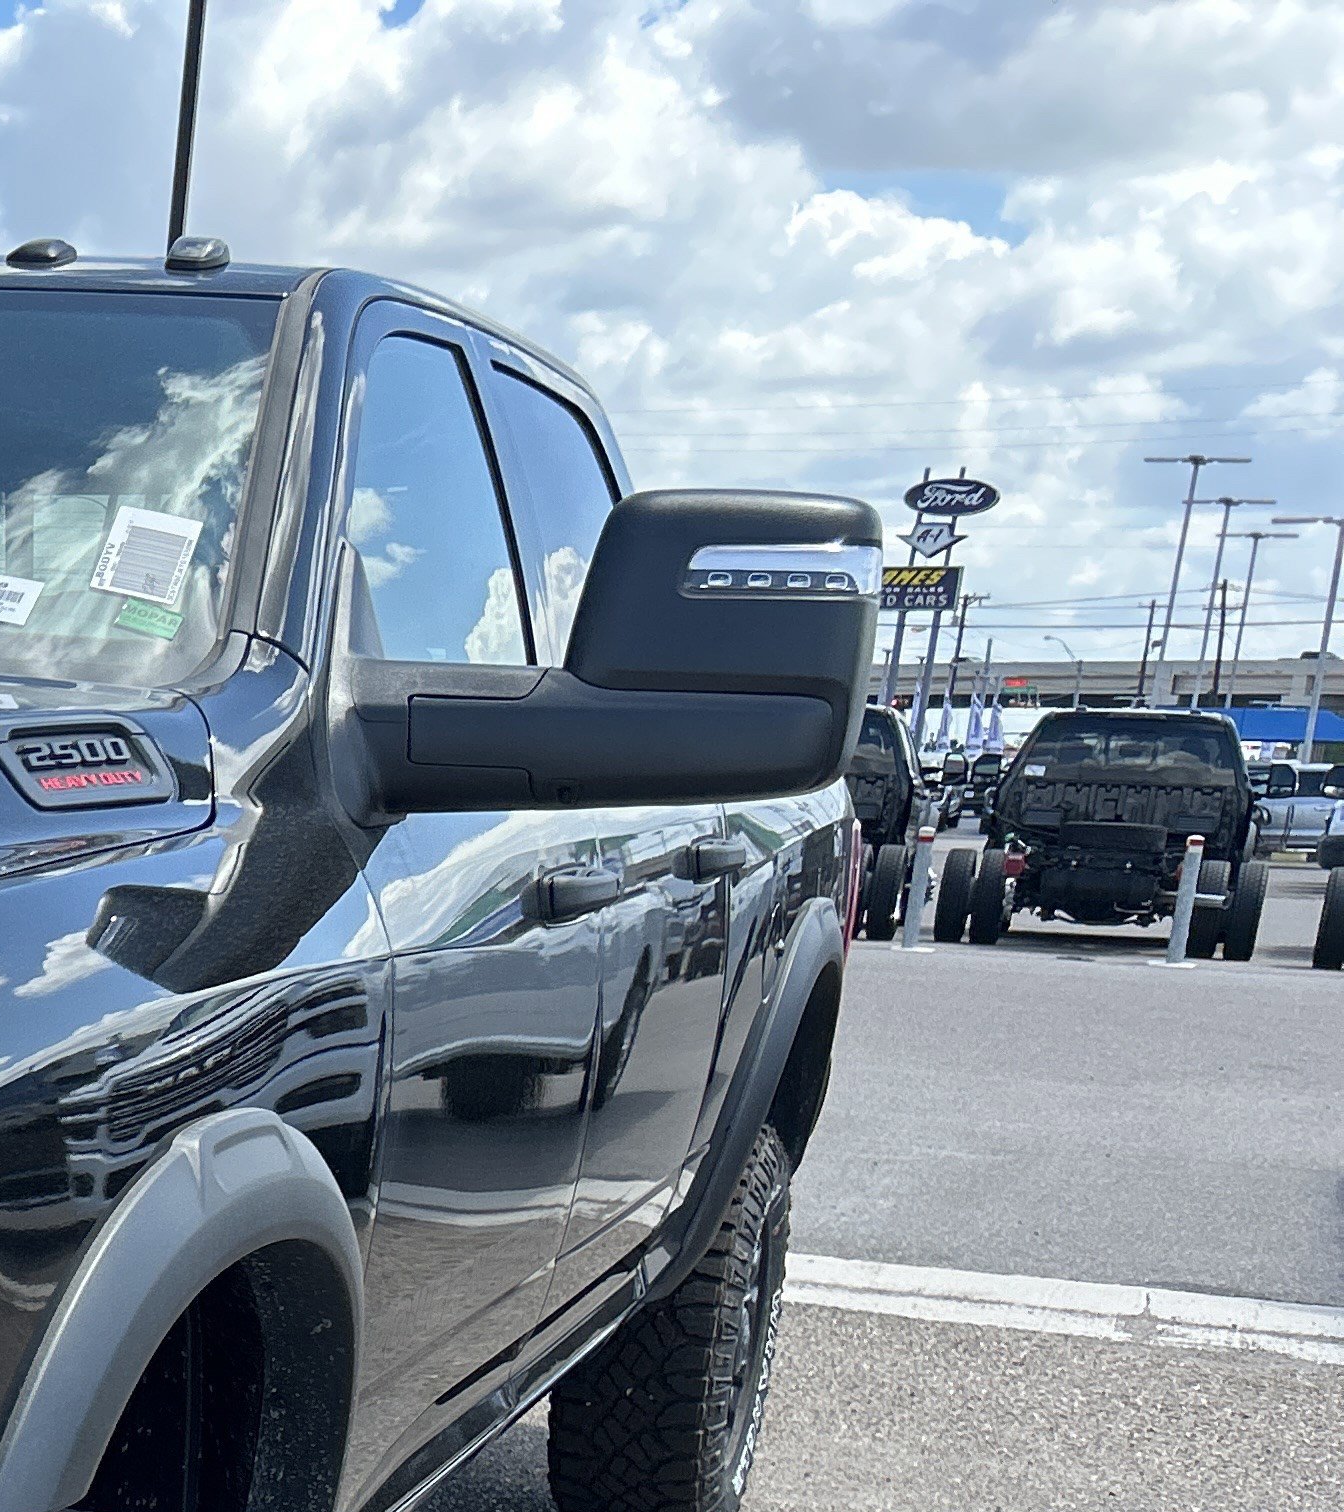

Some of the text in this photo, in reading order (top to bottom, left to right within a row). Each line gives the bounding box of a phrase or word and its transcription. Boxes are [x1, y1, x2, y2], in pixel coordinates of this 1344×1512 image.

[917, 483, 987, 508] Ford
[904, 594, 949, 607] CARS
[22, 737, 132, 770] 2500
[39, 770, 142, 791] HEAVY DUTY
